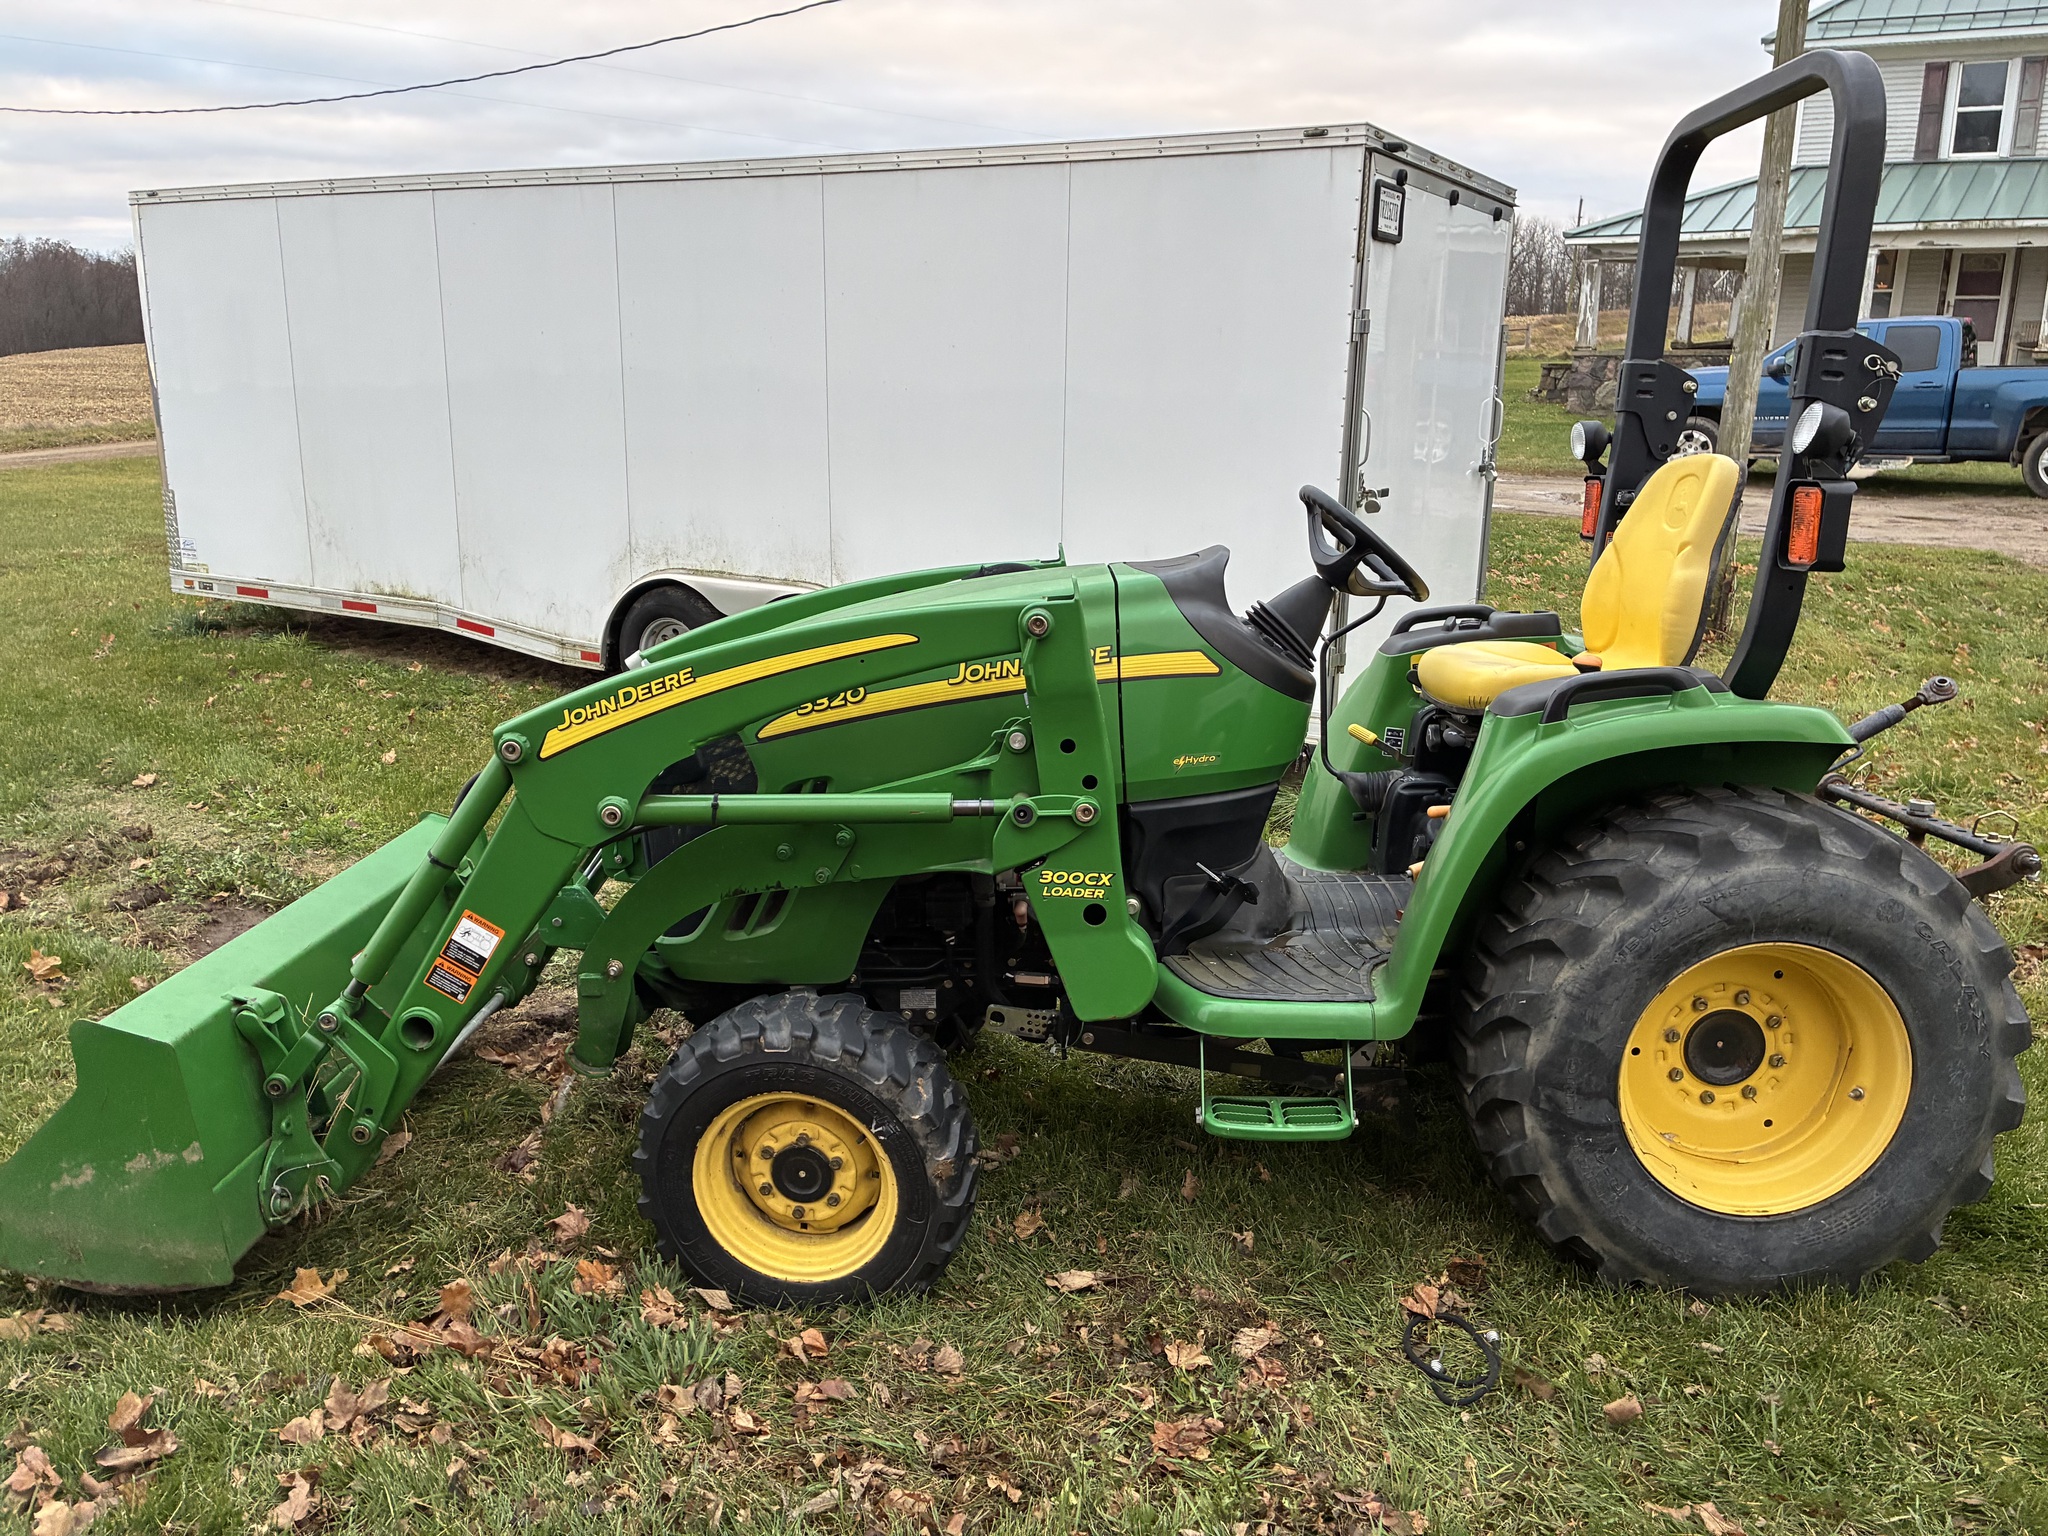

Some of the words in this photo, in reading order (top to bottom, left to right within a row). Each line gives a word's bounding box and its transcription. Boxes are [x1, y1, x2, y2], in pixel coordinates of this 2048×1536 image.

[947, 658, 1021, 685] JOHN
[557, 694, 617, 731] JOHN
[617, 666, 696, 709] DEERE
[1039, 869, 1115, 887] 300CX
[1042, 886, 1106, 899] LOADER
[473, 916, 500, 935] WARNING
[446, 964, 473, 983] WARNING
